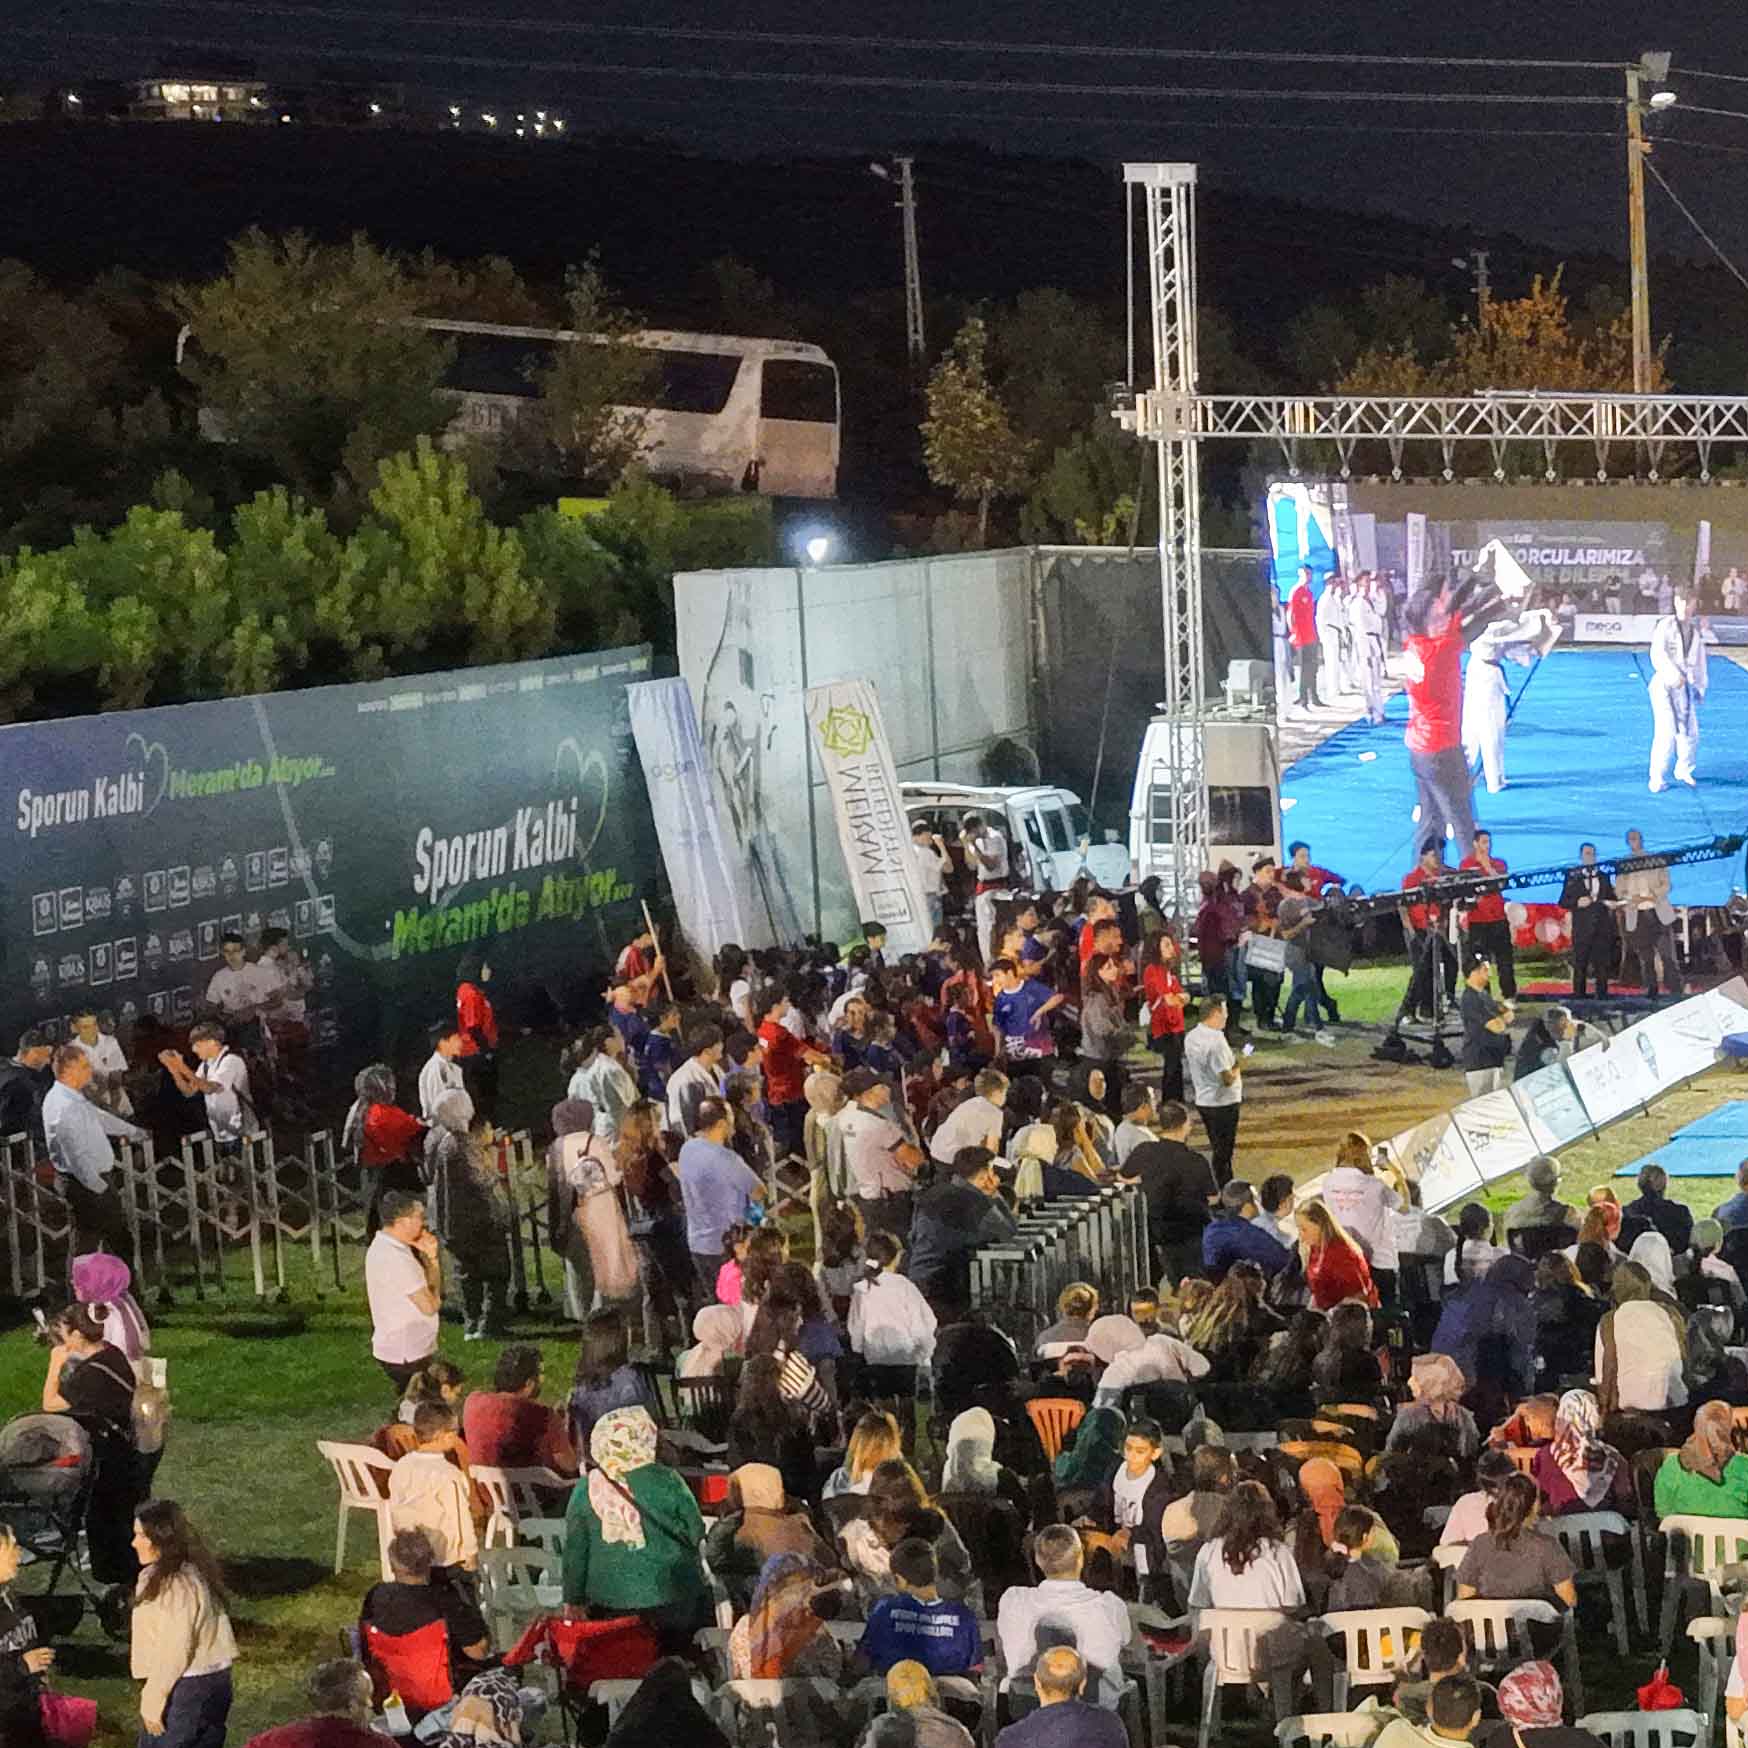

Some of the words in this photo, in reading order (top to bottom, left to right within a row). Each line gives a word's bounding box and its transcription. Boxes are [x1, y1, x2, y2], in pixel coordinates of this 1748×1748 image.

[17, 788, 89, 838] Sporun
[94, 772, 144, 818] Kalbi
[414, 826, 508, 905] Sporun
[512, 796, 578, 871] Kalbi
[392, 882, 530, 960] Meram'da
